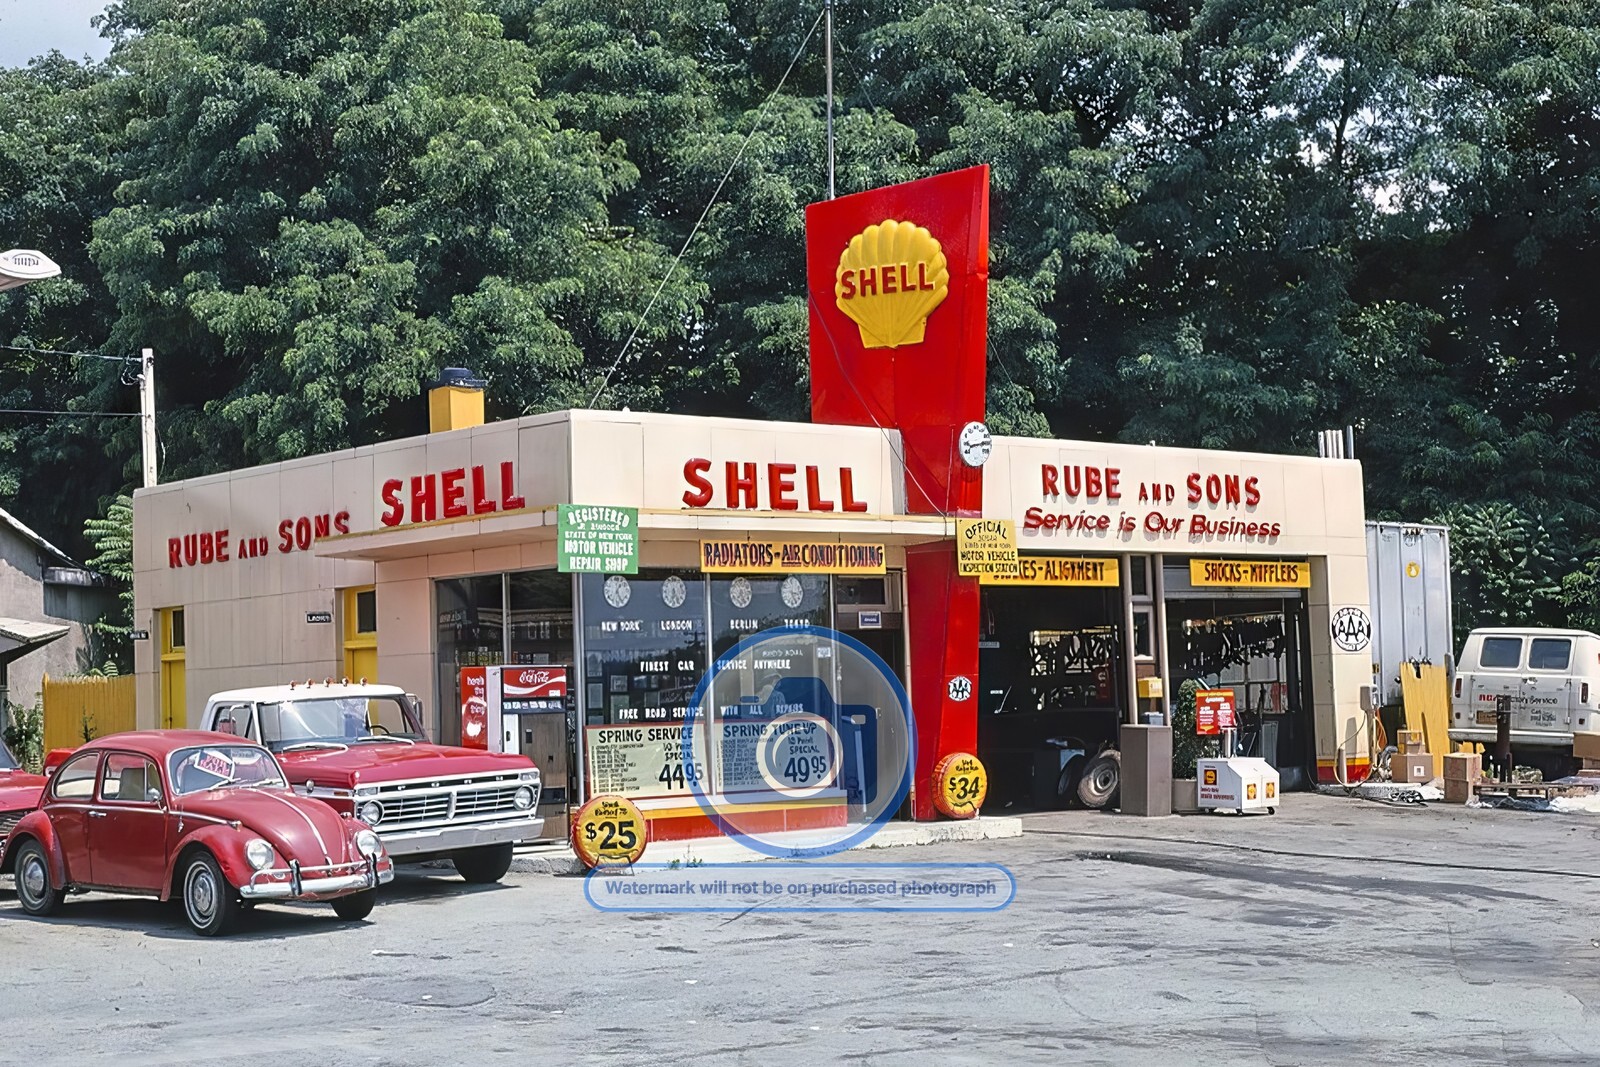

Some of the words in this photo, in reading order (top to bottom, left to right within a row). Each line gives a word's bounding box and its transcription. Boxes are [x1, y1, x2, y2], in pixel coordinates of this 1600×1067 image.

[841, 262, 934, 300] SHELL
[381, 461, 526, 527] SHELL
[683, 458, 867, 512] SHELL
[1041, 464, 1121, 499] RUBE
[1138, 482, 1175, 500] AND
[1186, 472, 1261, 506] SONS
[568, 507, 630, 527] REGISTERED
[1024, 507, 1110, 531] Service
[1118, 511, 1136, 533] is
[1144, 511, 1184, 533] Our
[1190, 514, 1281, 537] Business
[168, 529, 230, 568] RUBE
[238, 536, 268, 559] AND
[278, 511, 350, 553] SONS
[965, 521, 1007, 540] OFFICIAL
[565, 540, 596, 554] MOTOR
[598, 541, 634, 556] VEHICLE
[570, 556, 601, 571] REPAIR
[605, 557, 629, 571] SHOP
[730, 619, 758, 630] BERLIN
[1338, 615, 1366, 642] AAA
[640, 661, 668, 672] FINEST
[678, 660, 694, 671] CAR
[754, 659, 791, 670] ANYWHERE
[619, 709, 638, 719] FREE
[646, 708, 666, 718] ROAD
[599, 729, 643, 743] SPRING
[648, 727, 693, 741] SERVICE
[724, 724, 768, 738] SPRING
[948, 776, 979, 799] $34
[585, 820, 637, 850] $25
